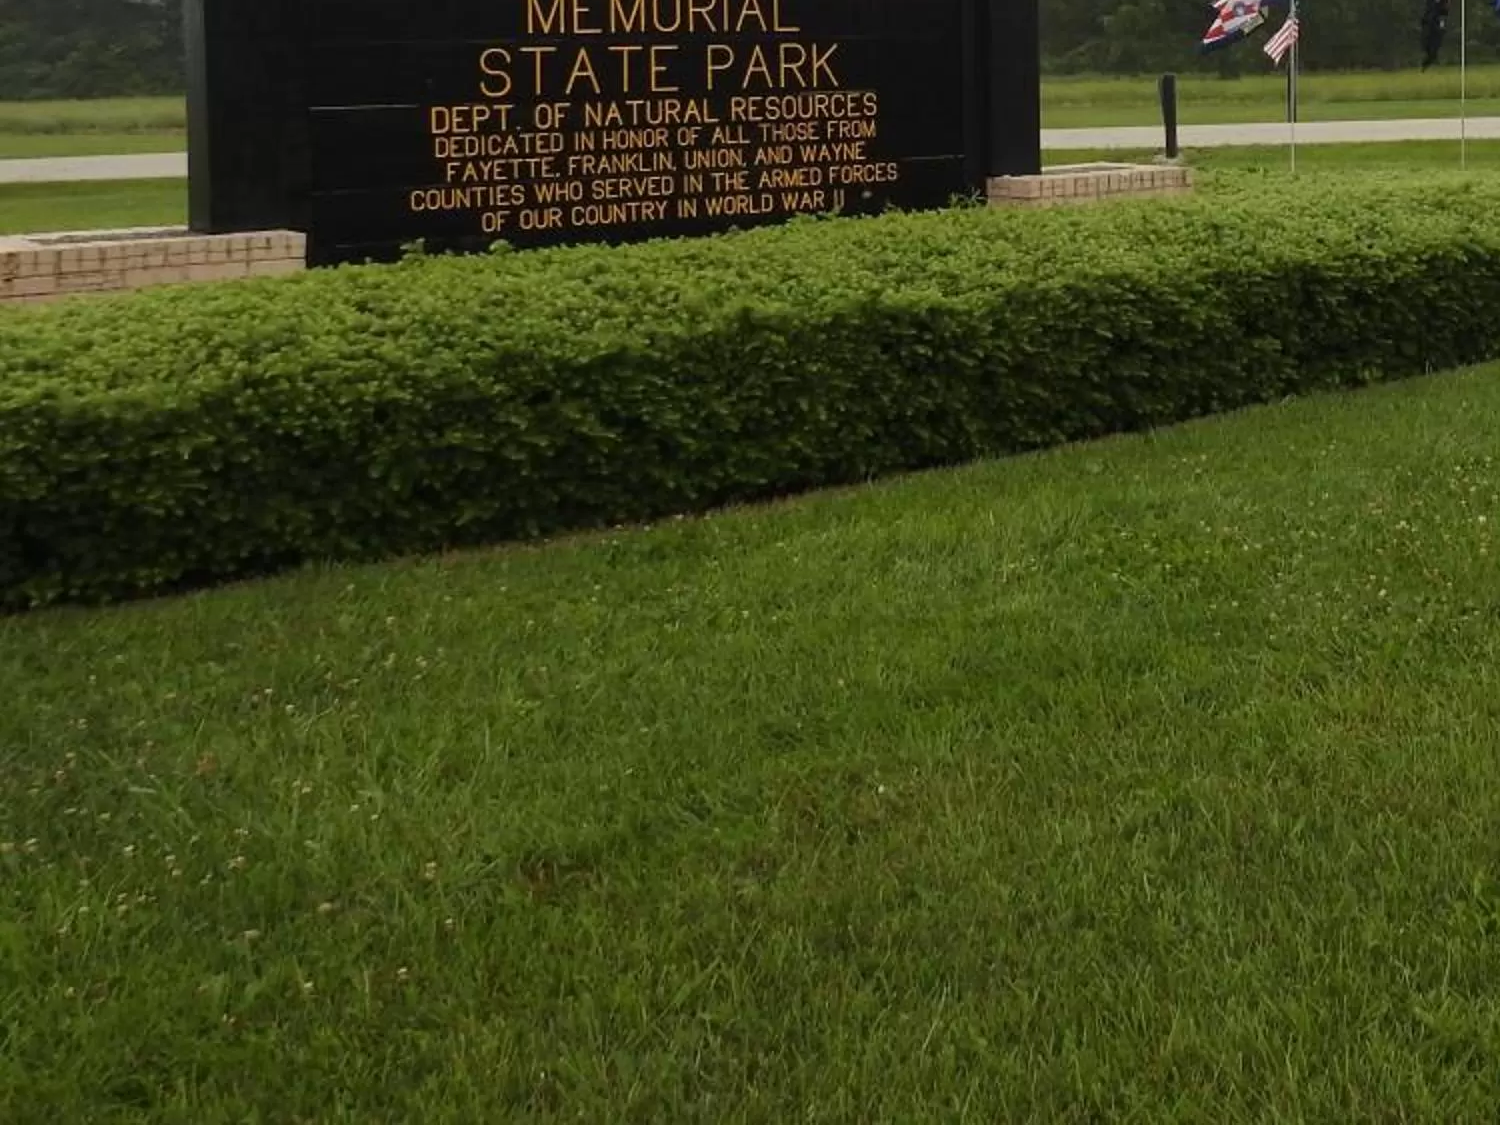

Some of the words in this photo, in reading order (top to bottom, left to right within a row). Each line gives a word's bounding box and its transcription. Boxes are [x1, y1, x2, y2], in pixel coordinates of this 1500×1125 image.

[479, 45, 679, 97] STATE
[707, 43, 839, 91] PARK
[431, 104, 522, 134] DEPT.
[535, 102, 571, 129] OF
[584, 98, 720, 127] NATURAL
[731, 92, 878, 122] RESOURCES
[435, 132, 564, 158] DEDICATED
[575, 130, 595, 151] IN
[603, 127, 669, 149] HONOR
[677, 126, 702, 146] OF
[711, 125, 751, 145] ALL
[757, 121, 820, 142] THOSE
[827, 118, 877, 139] FROM
[754, 145, 793, 166] AND
[800, 141, 867, 163] WAYNE
[411, 184, 526, 211] COUNTIES
[534, 181, 583, 203] WHO
[591, 176, 674, 200] SERVED
[683, 173, 703, 194] IN
[711, 171, 750, 192] THE
[759, 167, 823, 189] ARMED
[829, 163, 898, 184] FORCES
[481, 211, 511, 232] OF
[519, 207, 563, 229] OUR
[571, 200, 668, 226] COUNTRY
[677, 197, 697, 218] IN
[705, 193, 774, 217] WORLD
[781, 190, 825, 211] WAR
